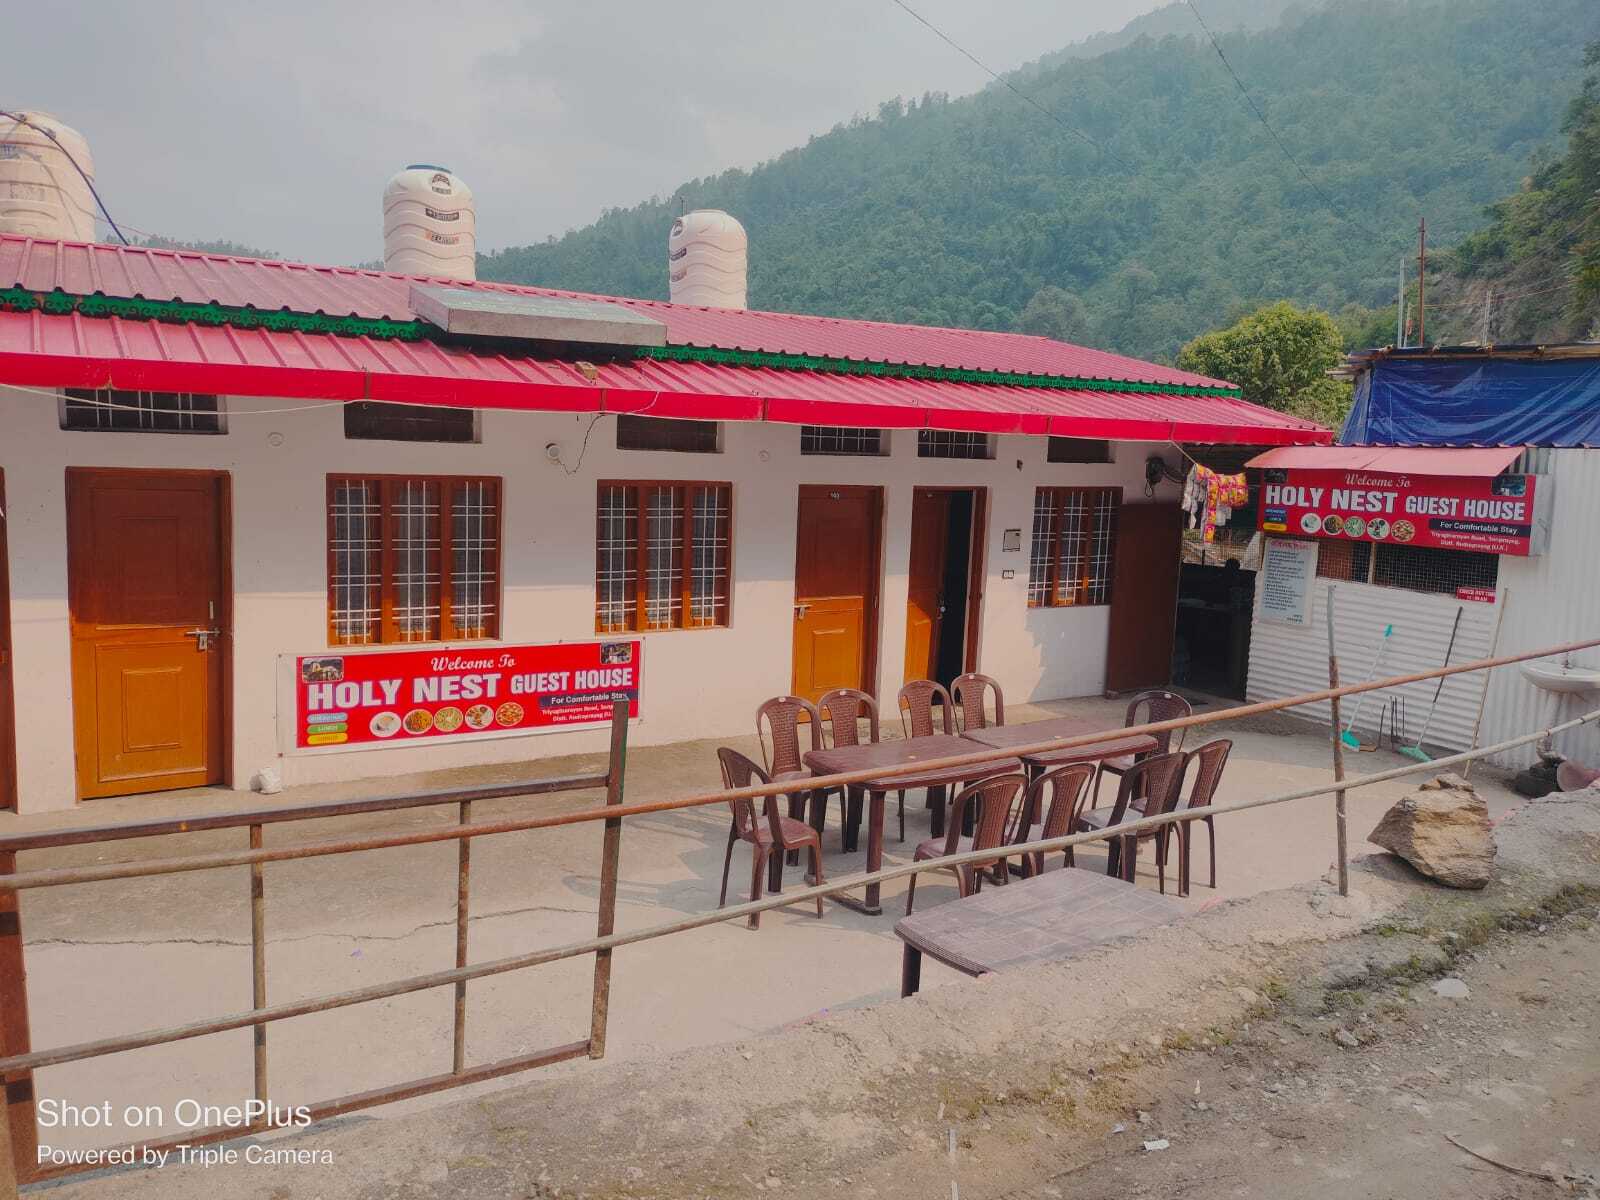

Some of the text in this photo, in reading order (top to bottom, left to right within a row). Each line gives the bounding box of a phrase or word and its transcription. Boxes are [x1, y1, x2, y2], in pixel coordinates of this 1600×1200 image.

[1345, 473, 1410, 488] Welcome To
[1265, 484, 1526, 520] HOLY NEST GUEST HOUSE
[1440, 521, 1518, 535] For Comfortable Stay
[431, 654, 517, 671] Welcome To
[307, 668, 632, 711] HOLY NEST GUEST HOUSE
[551, 696, 565, 705] For
[565, 694, 609, 704] Comfortable
